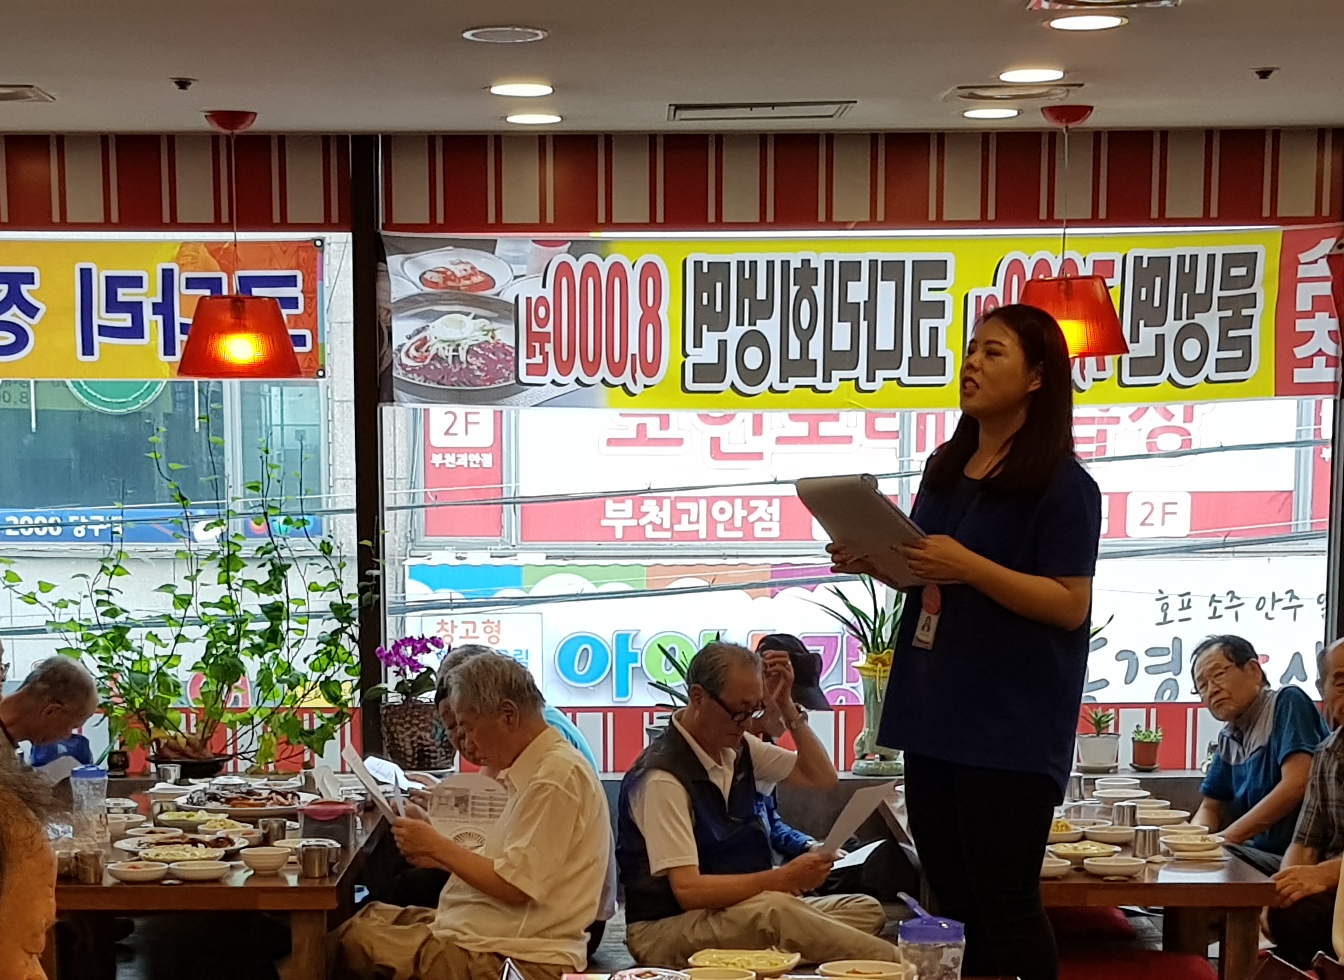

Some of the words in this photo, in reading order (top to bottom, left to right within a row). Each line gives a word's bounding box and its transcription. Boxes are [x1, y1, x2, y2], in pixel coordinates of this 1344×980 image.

[443, 410, 481, 437] 2F
[5, 515, 63, 537] 2000
[600, 499, 782, 540] 부천괴안점
[1139, 501, 1179, 527] 2F
[1154, 588, 1193, 627] 호프
[1207, 589, 1246, 623] 소주
[1254, 588, 1305, 623] 안주
[435, 618, 502, 645] 창고형
